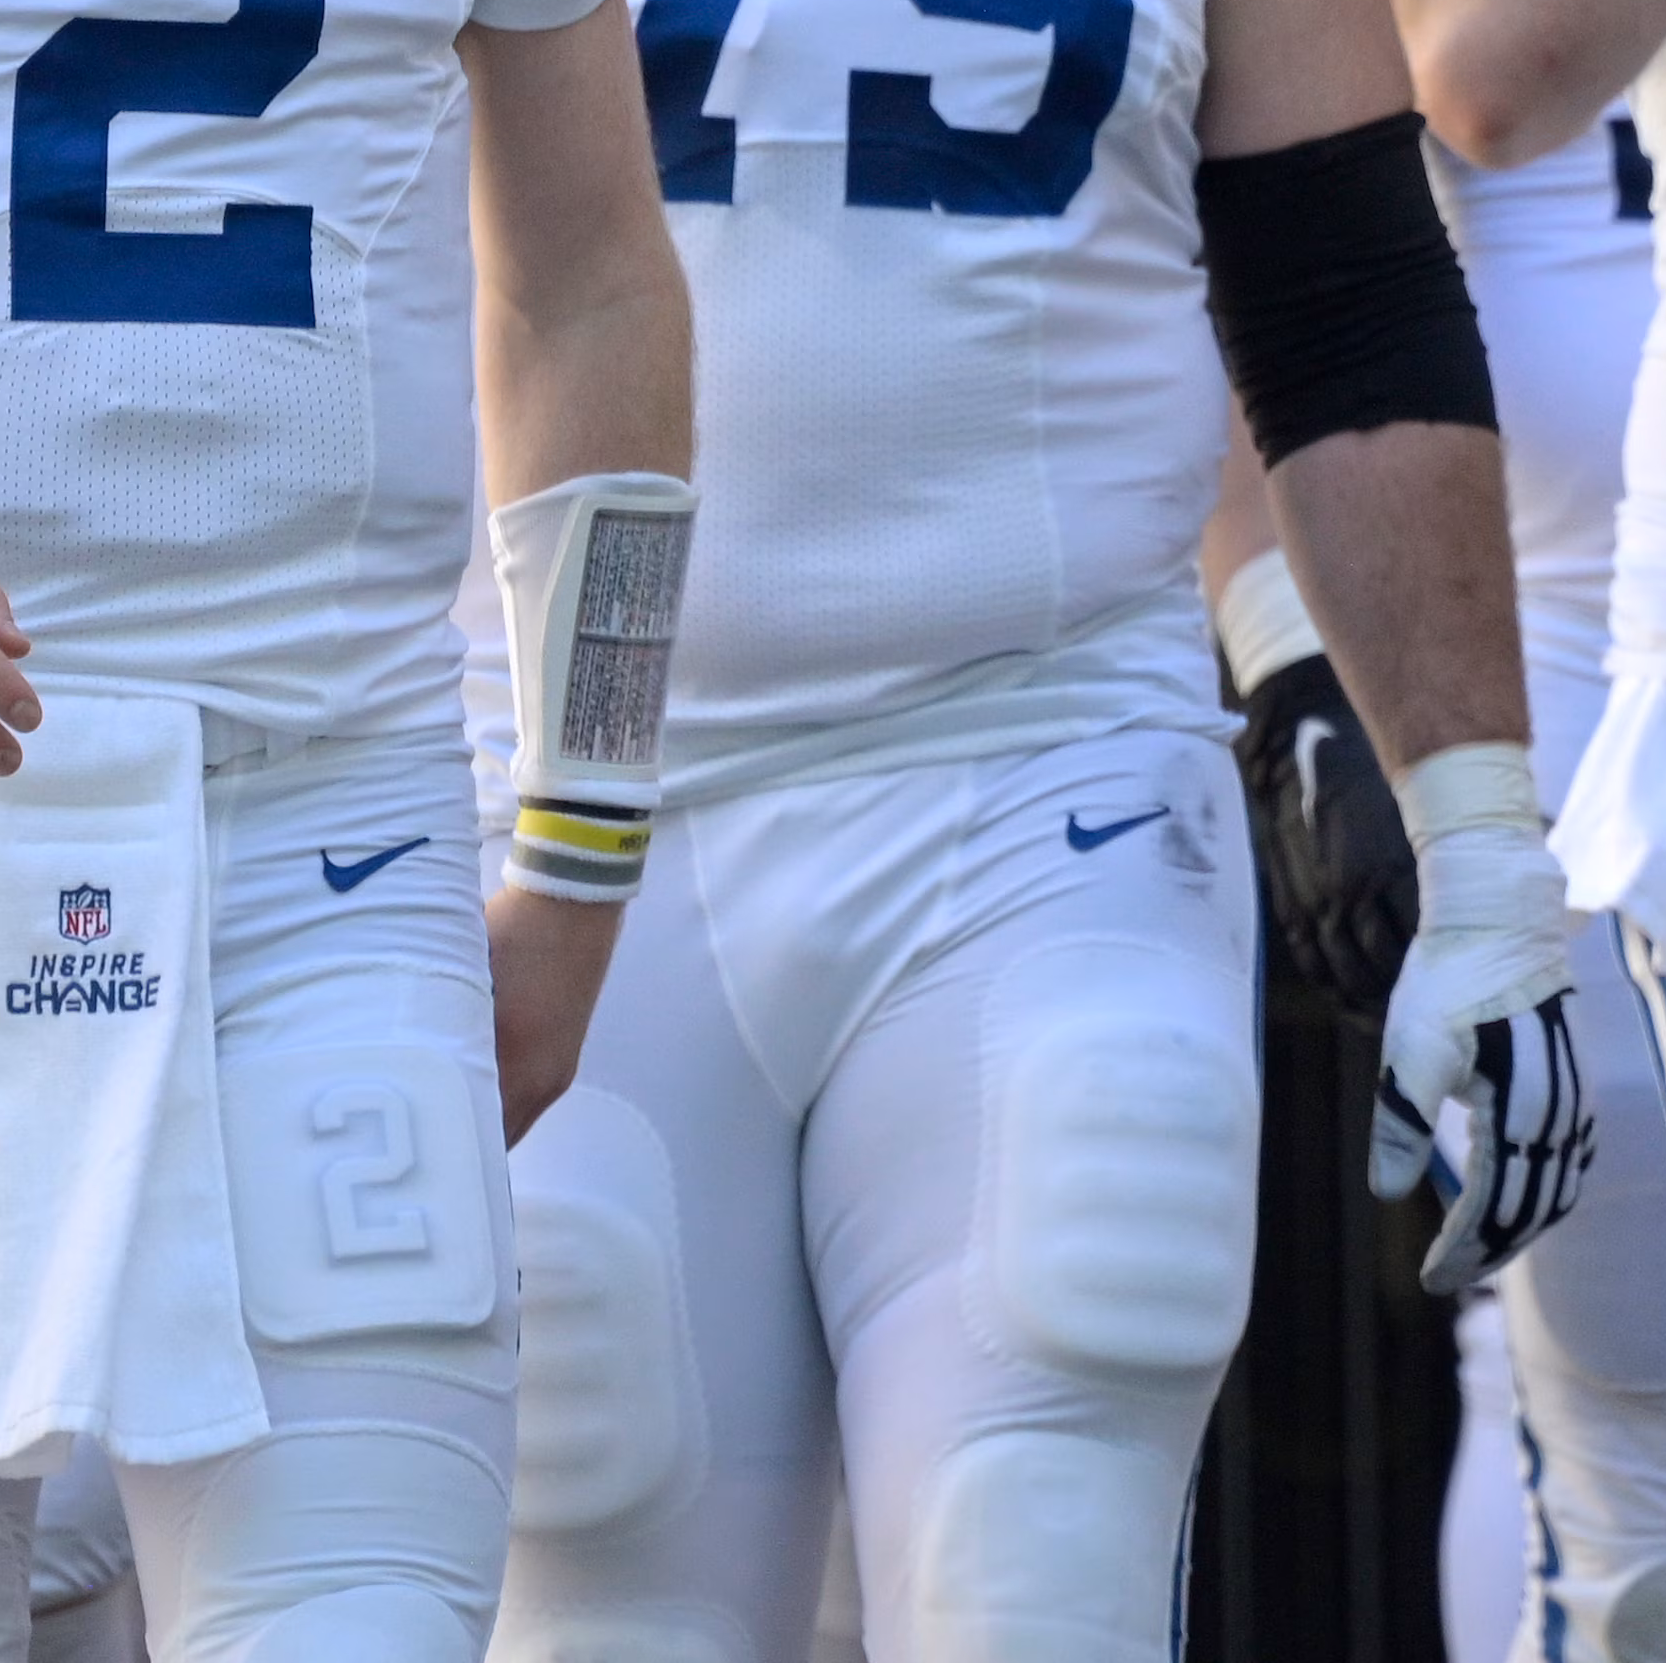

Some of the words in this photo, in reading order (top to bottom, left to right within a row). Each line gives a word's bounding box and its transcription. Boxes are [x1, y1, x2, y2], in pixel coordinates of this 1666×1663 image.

[64, 910, 107, 938] NFL
[30, 952, 145, 982] INSPIRE
[6, 974, 161, 1015] CHANGE
[311, 1084, 430, 1263] 2
